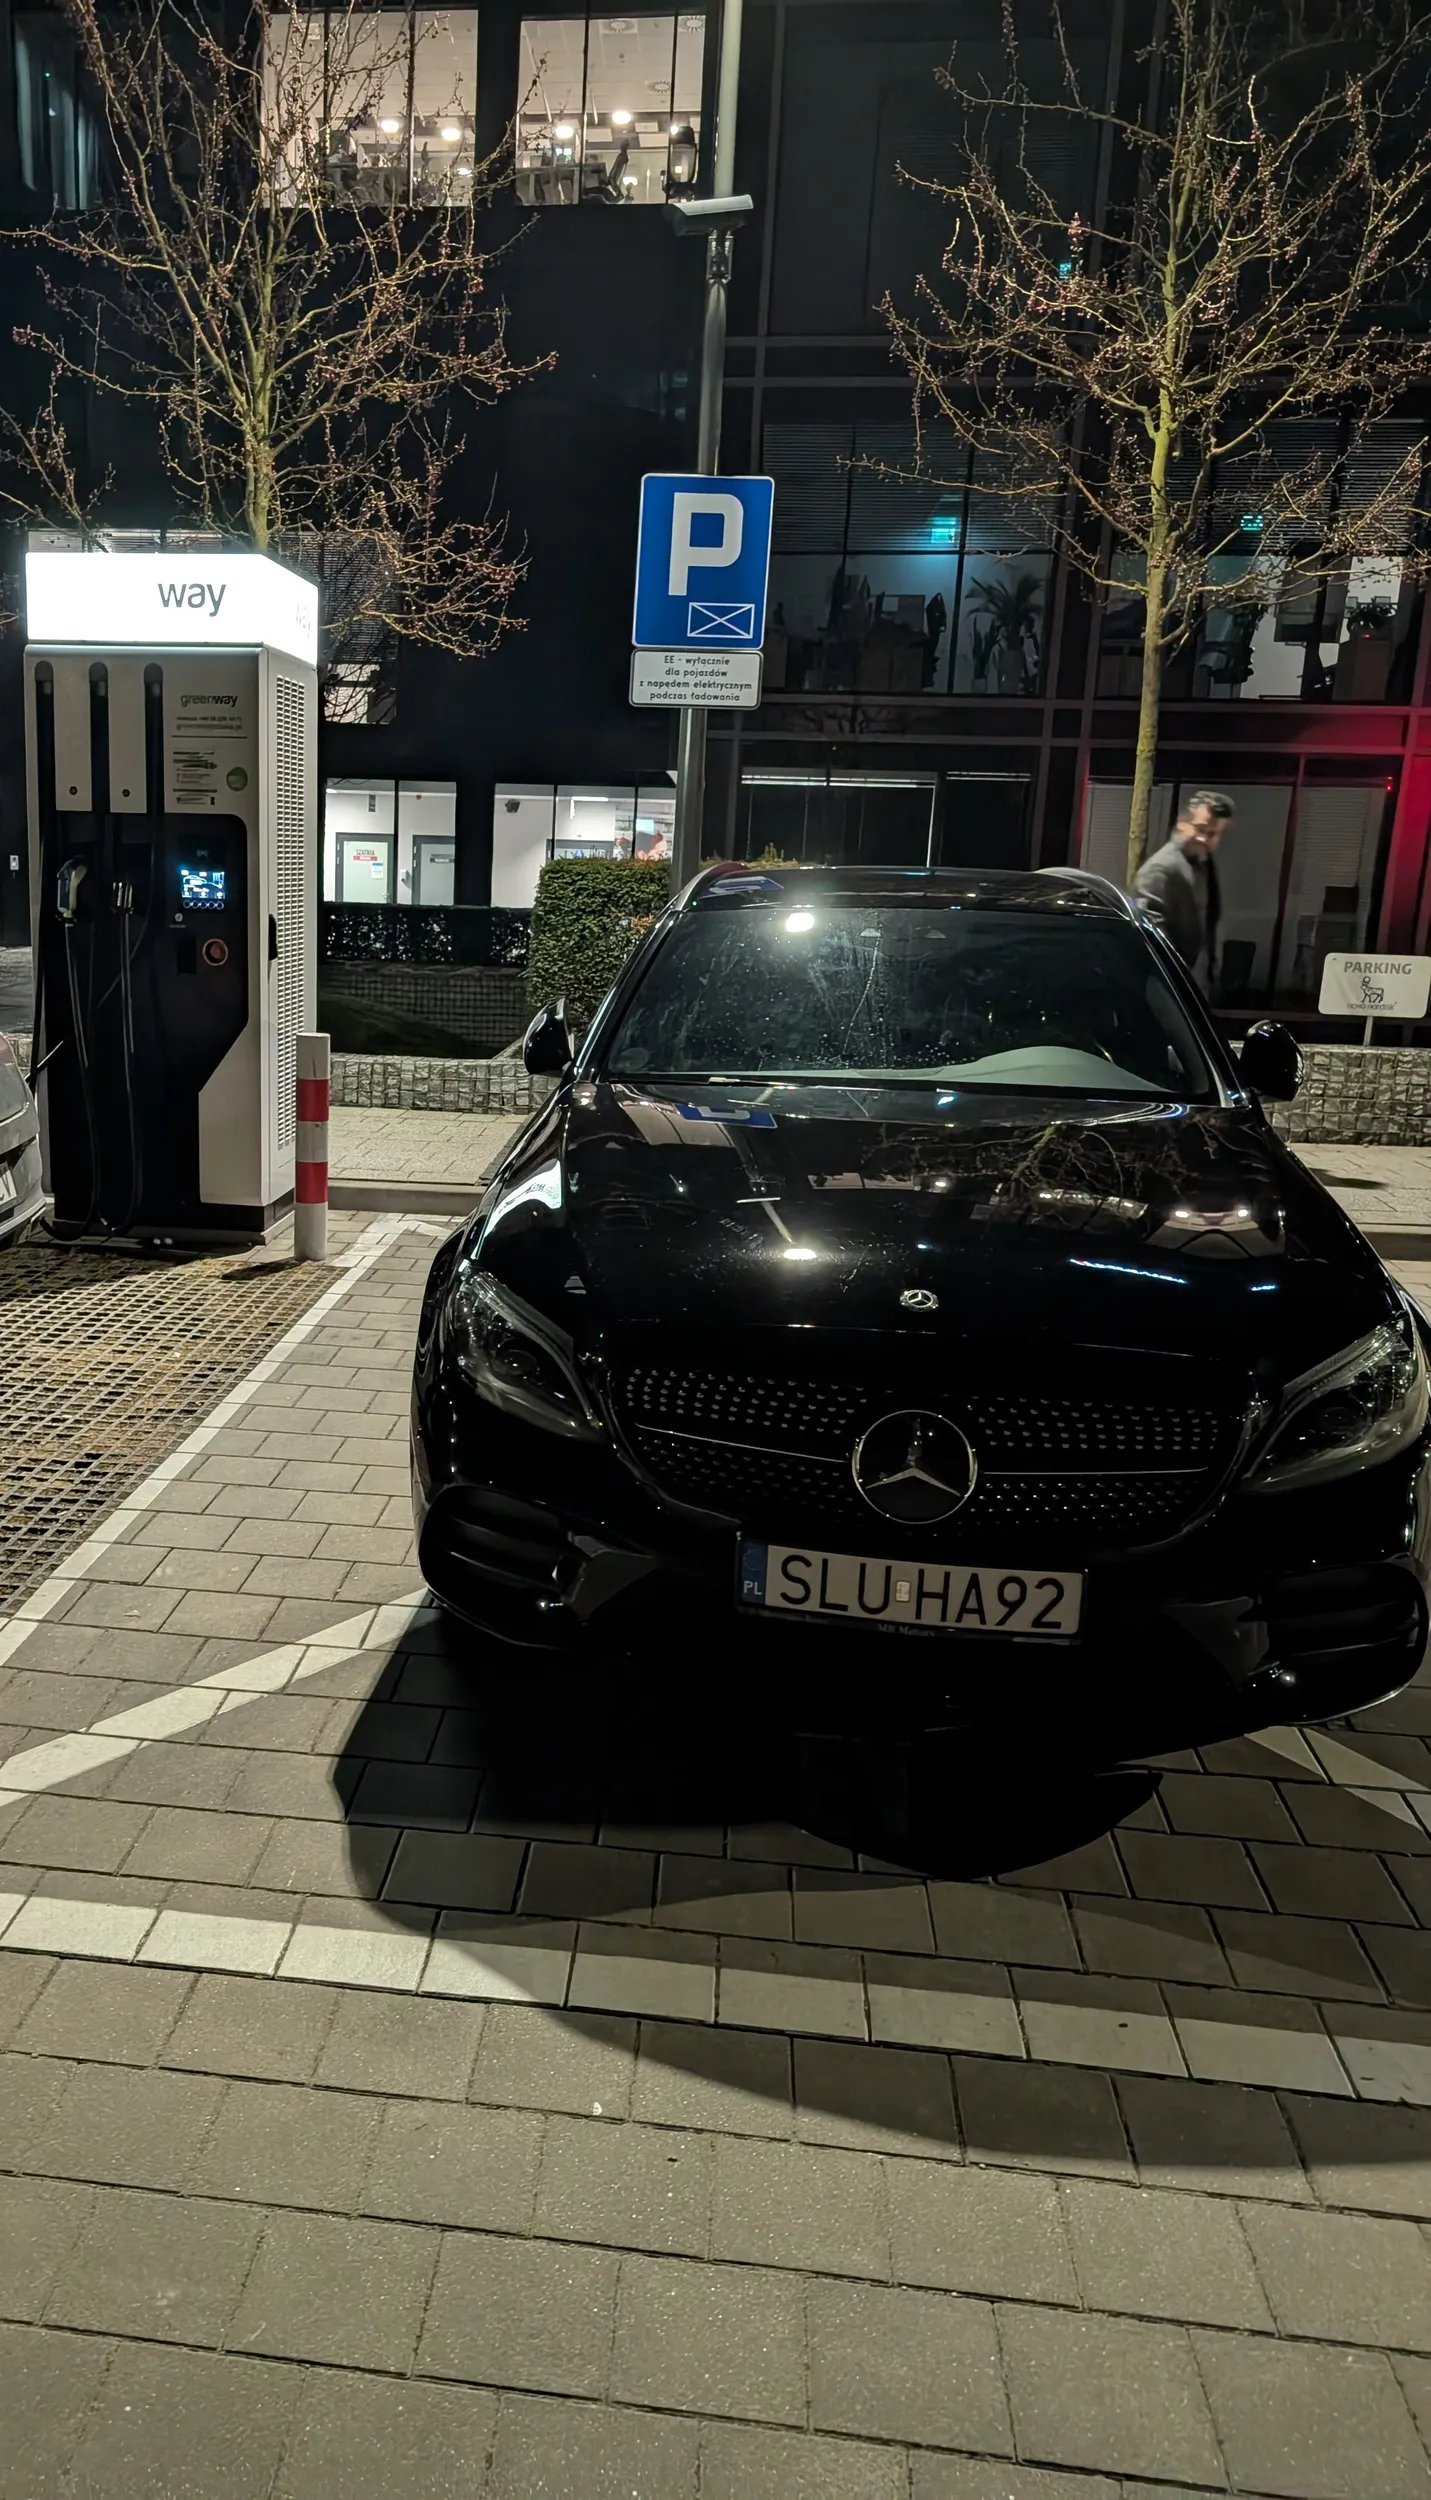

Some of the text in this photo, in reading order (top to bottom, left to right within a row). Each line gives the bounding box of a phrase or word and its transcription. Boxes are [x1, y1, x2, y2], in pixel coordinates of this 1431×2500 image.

[668, 492, 744, 596] P
[157, 583, 227, 617] way
[664, 655, 675, 664] EE
[685, 656, 730, 667] wyłącznie
[665, 667, 728, 678] dla pojazdów
[647, 680, 690, 689] napędem
[693, 681, 752, 691] elektrycznym
[180, 694, 239, 708] greenway
[649, 691, 740, 701] podczas ładowania
[1344, 961, 1412, 975] PARKING
[743, 1580, 763, 1596] PL
